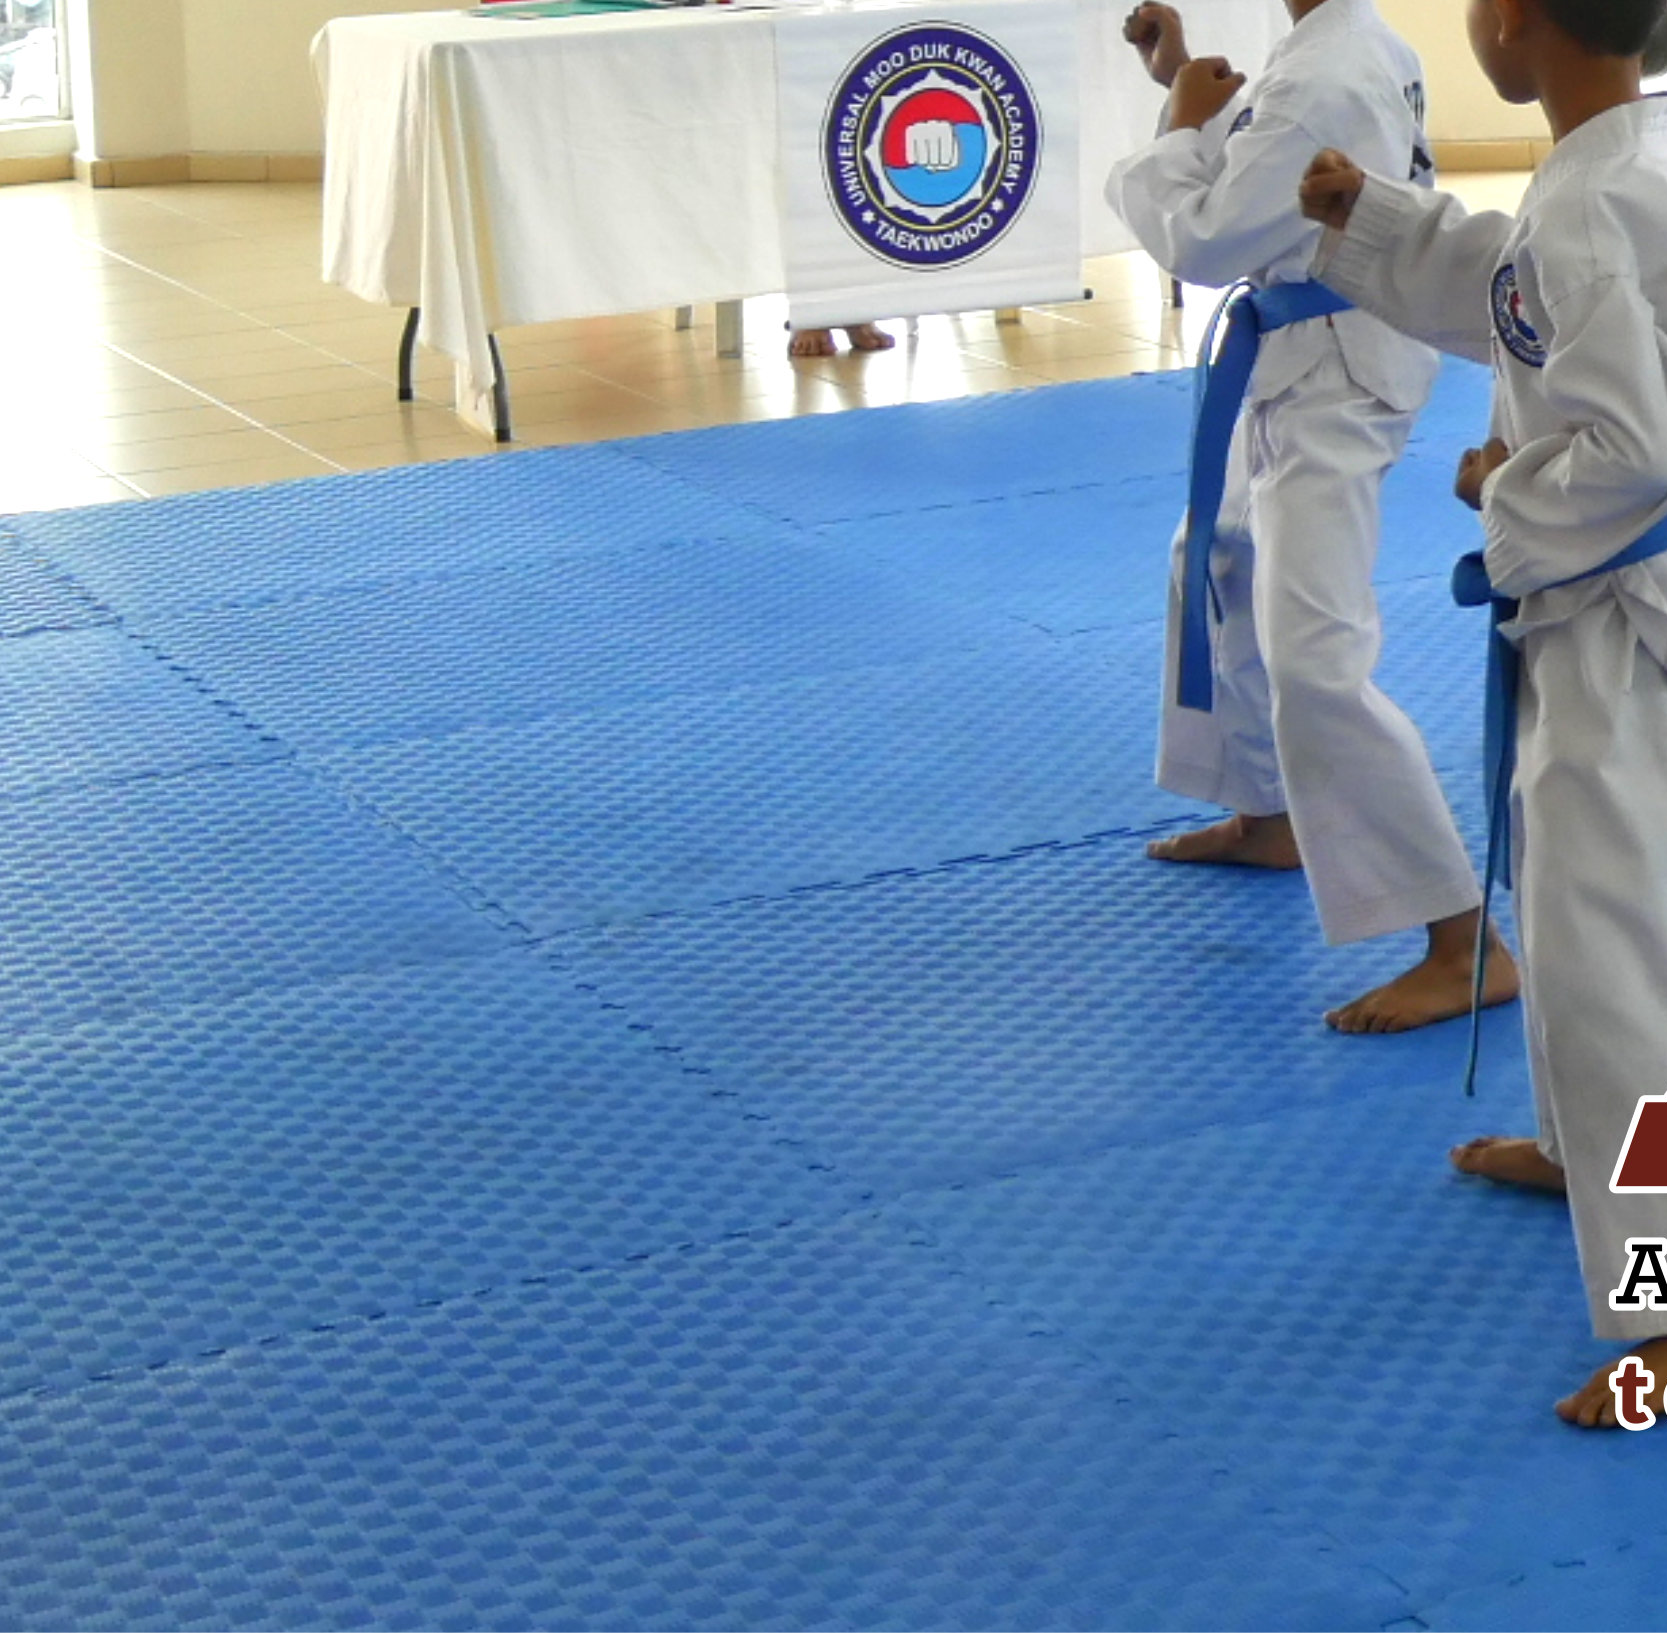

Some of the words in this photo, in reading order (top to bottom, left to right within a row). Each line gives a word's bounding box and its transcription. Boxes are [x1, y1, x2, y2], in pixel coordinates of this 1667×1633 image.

[838, 91, 870, 208] UNIVERSAL
[862, 51, 905, 87] MOO
[910, 43, 951, 62] DUK
[954, 47, 1005, 92] KWAN
[998, 93, 1025, 195] ACADEMY
[875, 212, 994, 252] TAEKWONDO
